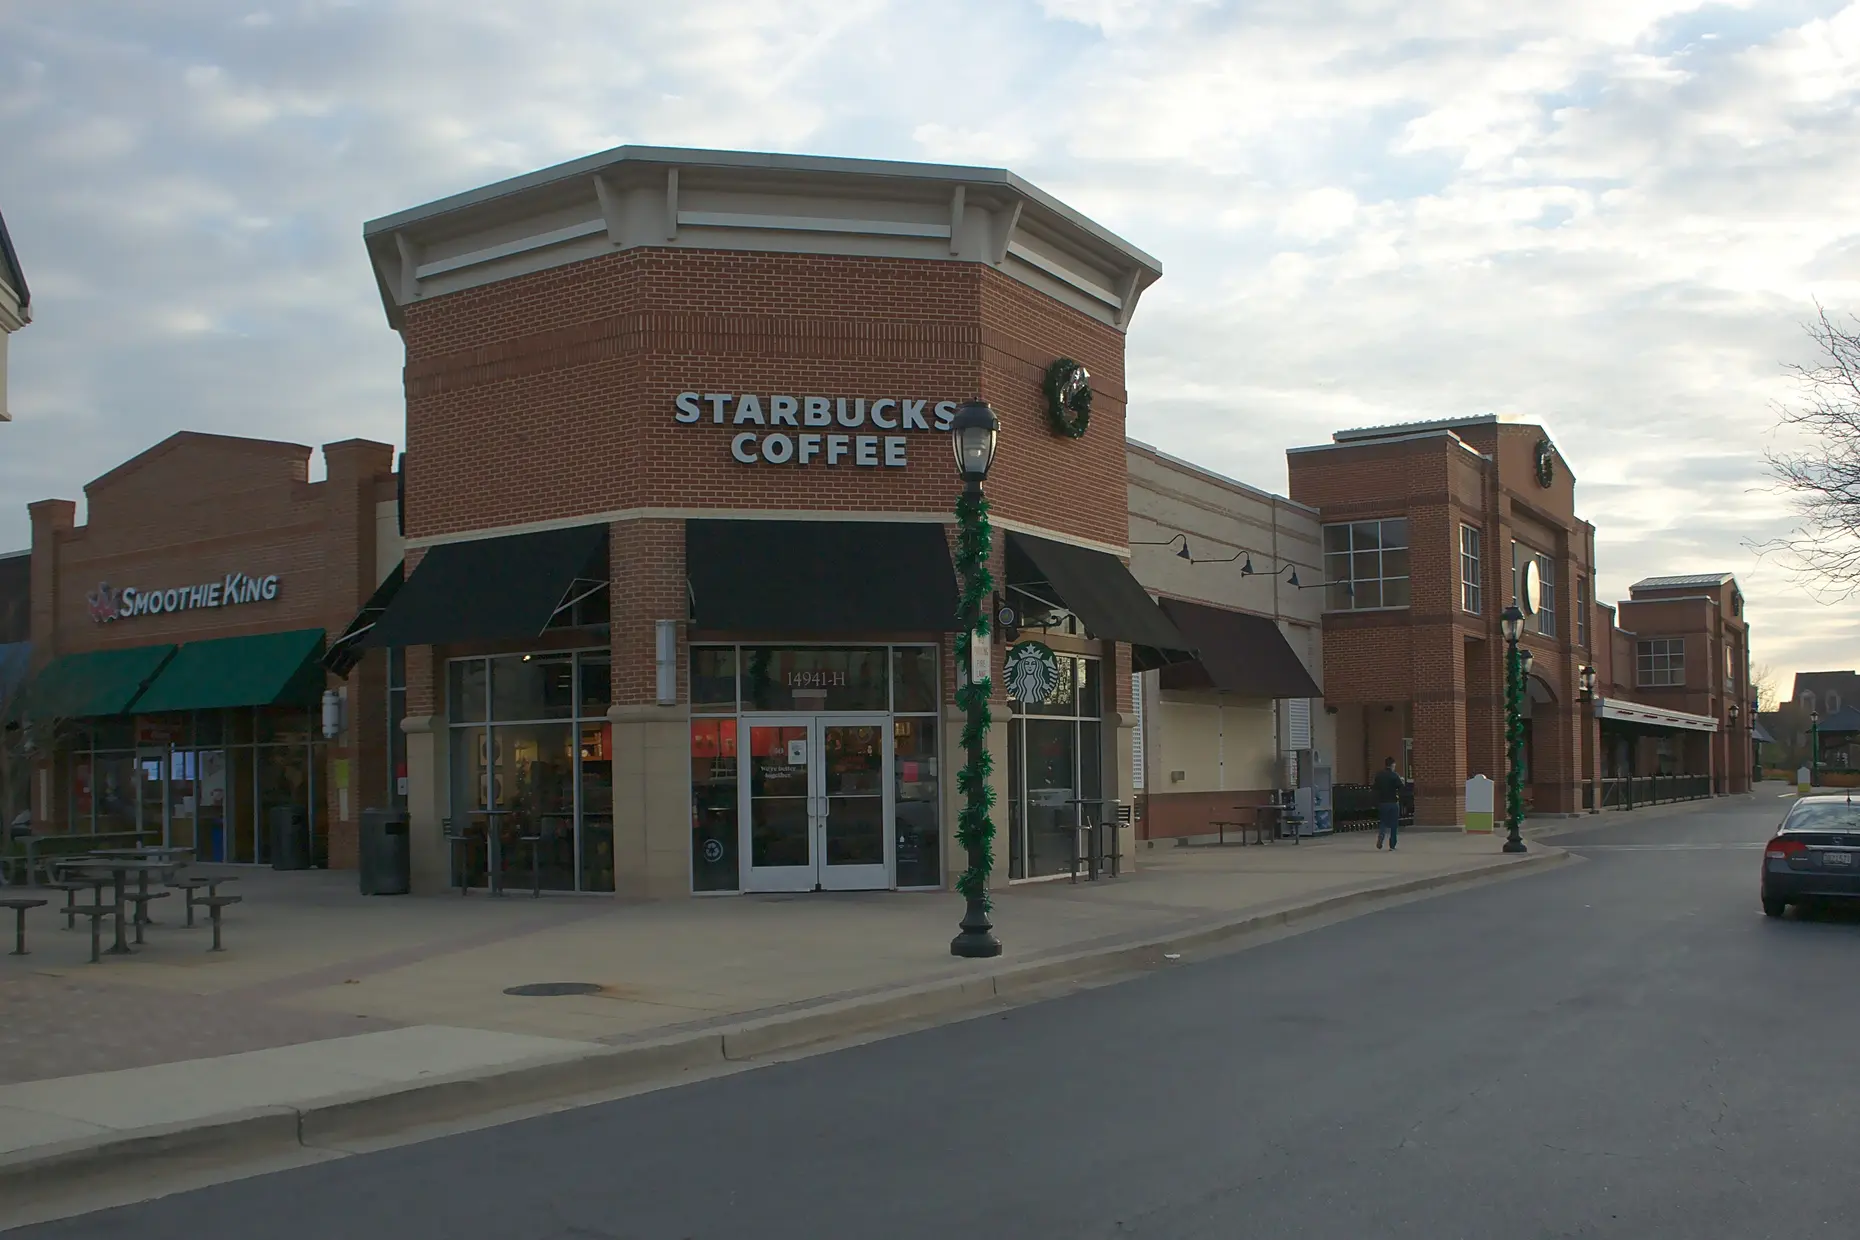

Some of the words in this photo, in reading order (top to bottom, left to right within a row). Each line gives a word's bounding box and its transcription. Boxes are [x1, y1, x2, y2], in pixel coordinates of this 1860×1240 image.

[675, 392, 957, 430] STARBUCKS
[731, 432, 907, 466] COFFEE
[120, 582, 221, 617] SMOOTHIE
[787, 671, 846, 687] 14941-H
